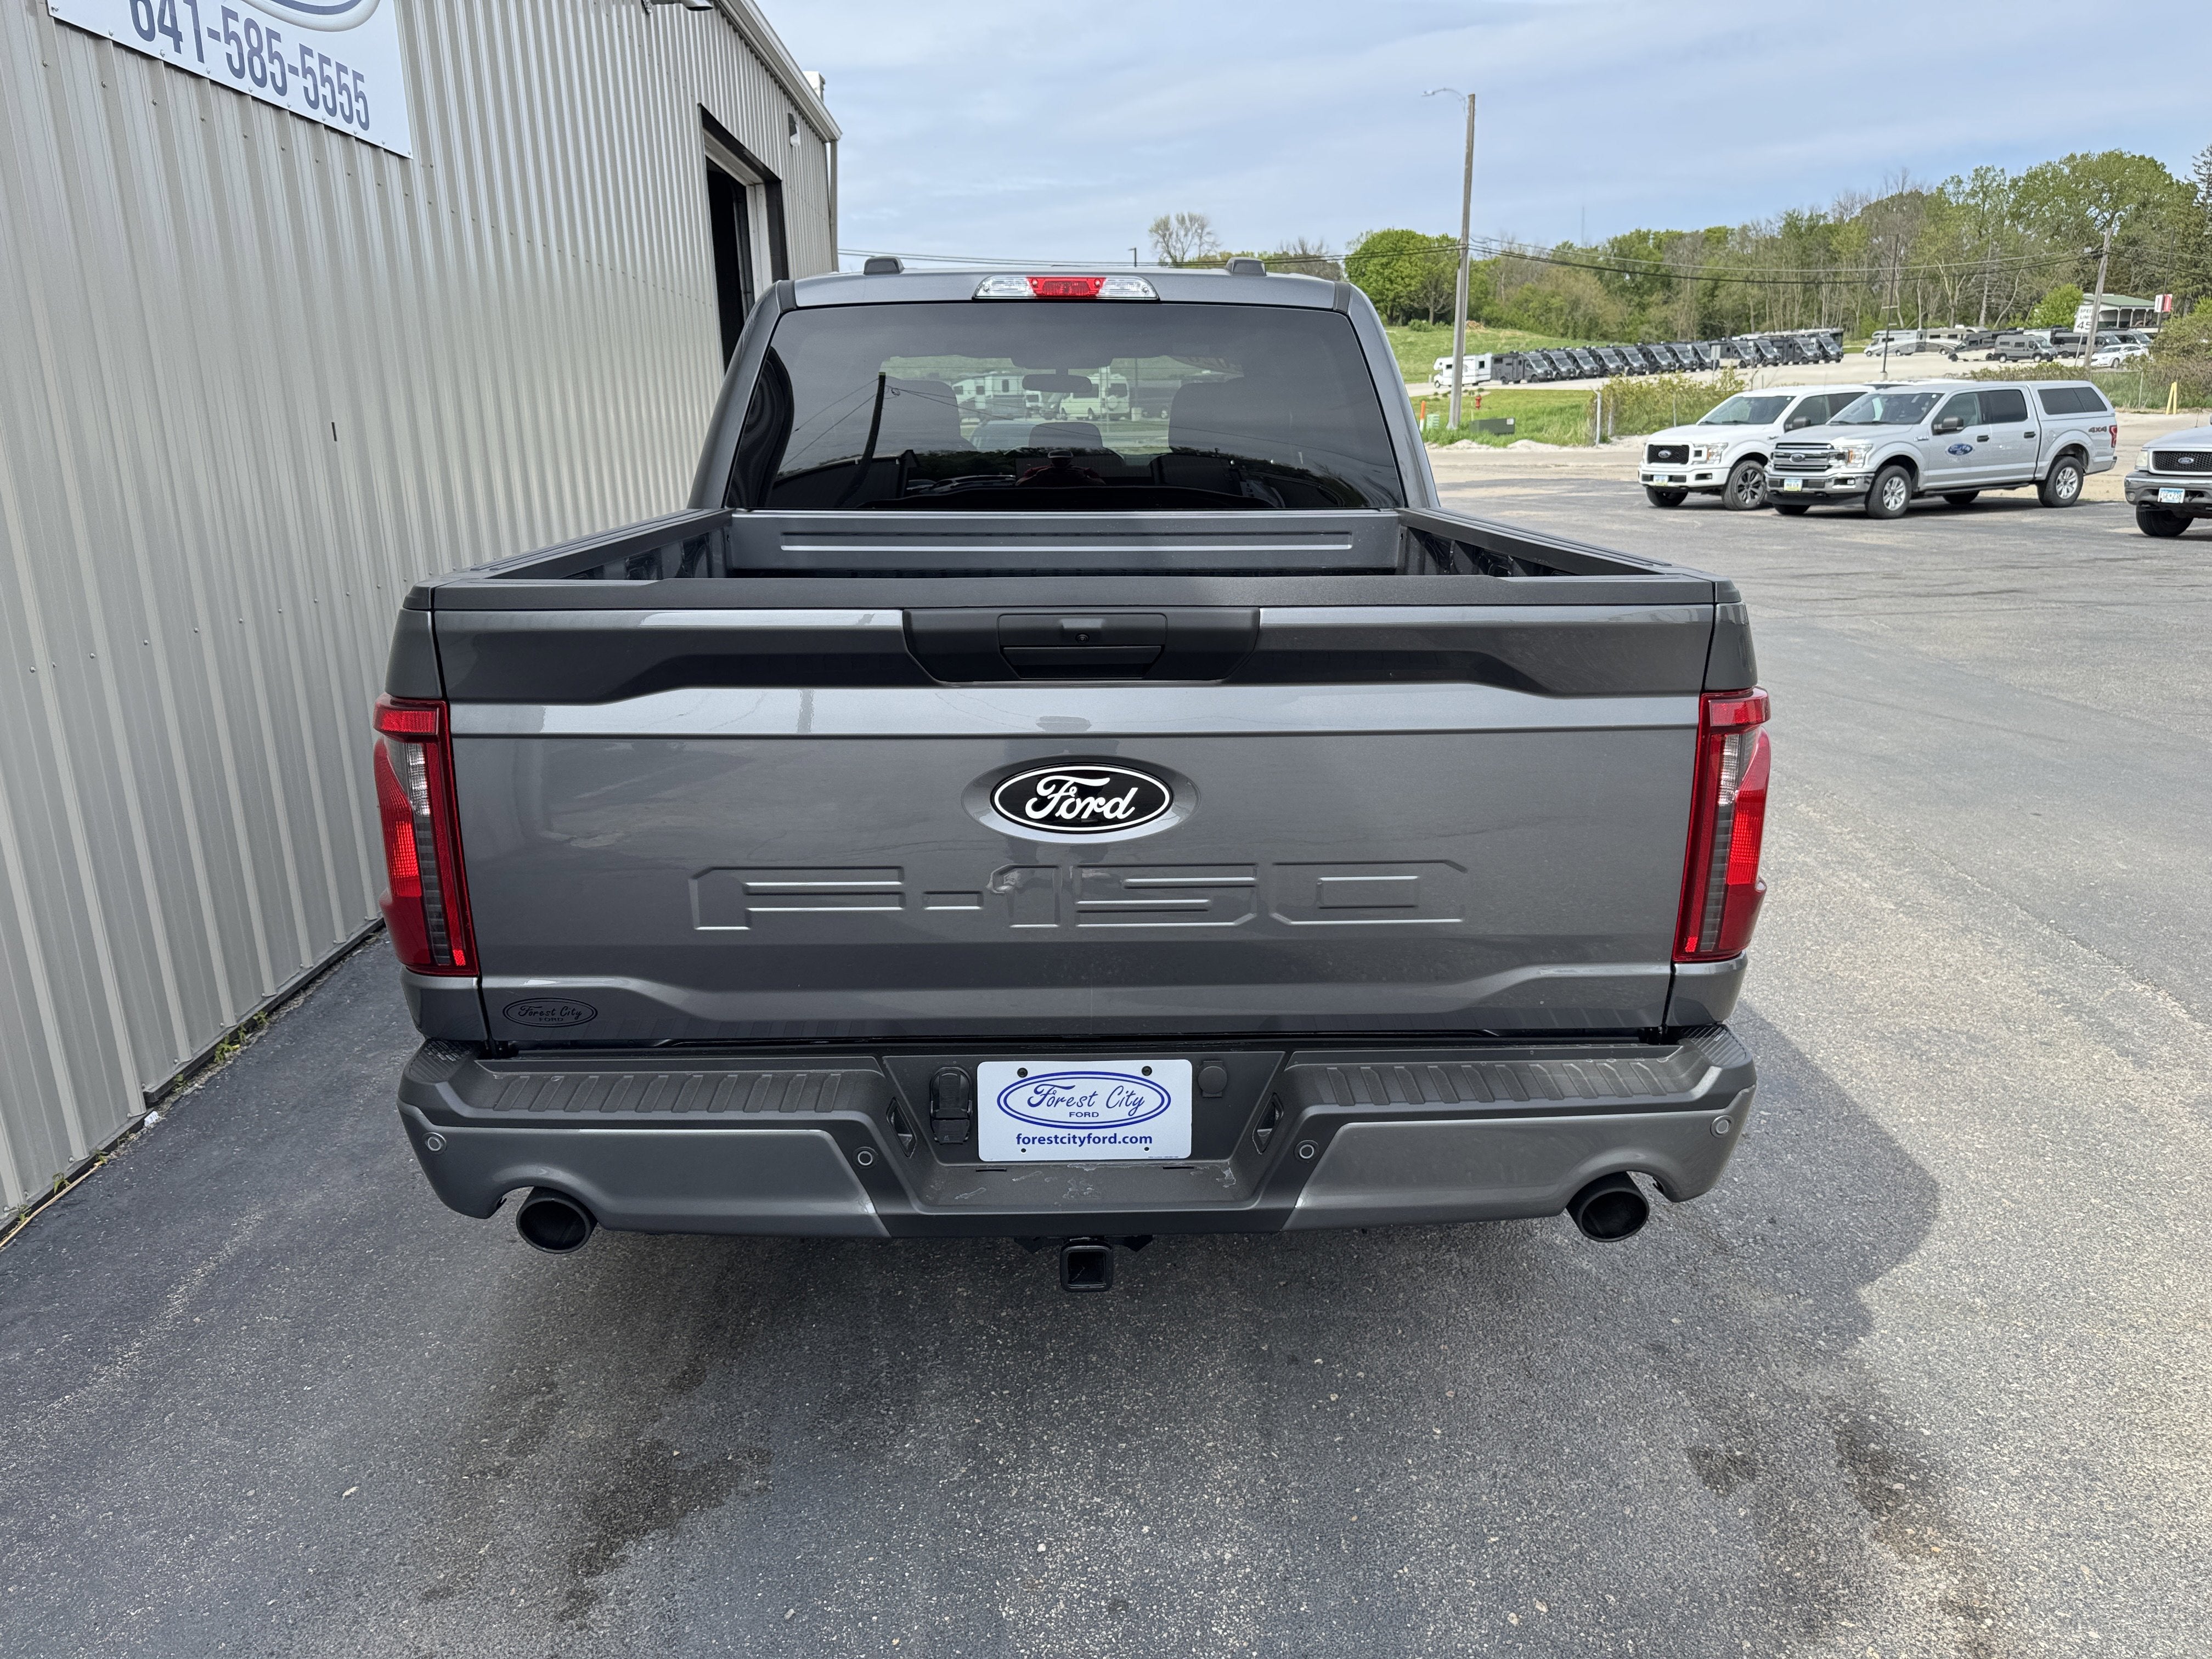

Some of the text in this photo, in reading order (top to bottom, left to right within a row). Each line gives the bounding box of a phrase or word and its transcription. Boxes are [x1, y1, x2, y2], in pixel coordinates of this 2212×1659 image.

[129, 0, 370, 131] 641-585-5555
[1025, 775, 1138, 819] Ford
[688, 859, 1468, 930] F-150
[518, 1005, 583, 1020] Forest City
[1027, 1084, 1146, 1116] Forest City
[1015, 1133, 1153, 1147] forestcityford.com
